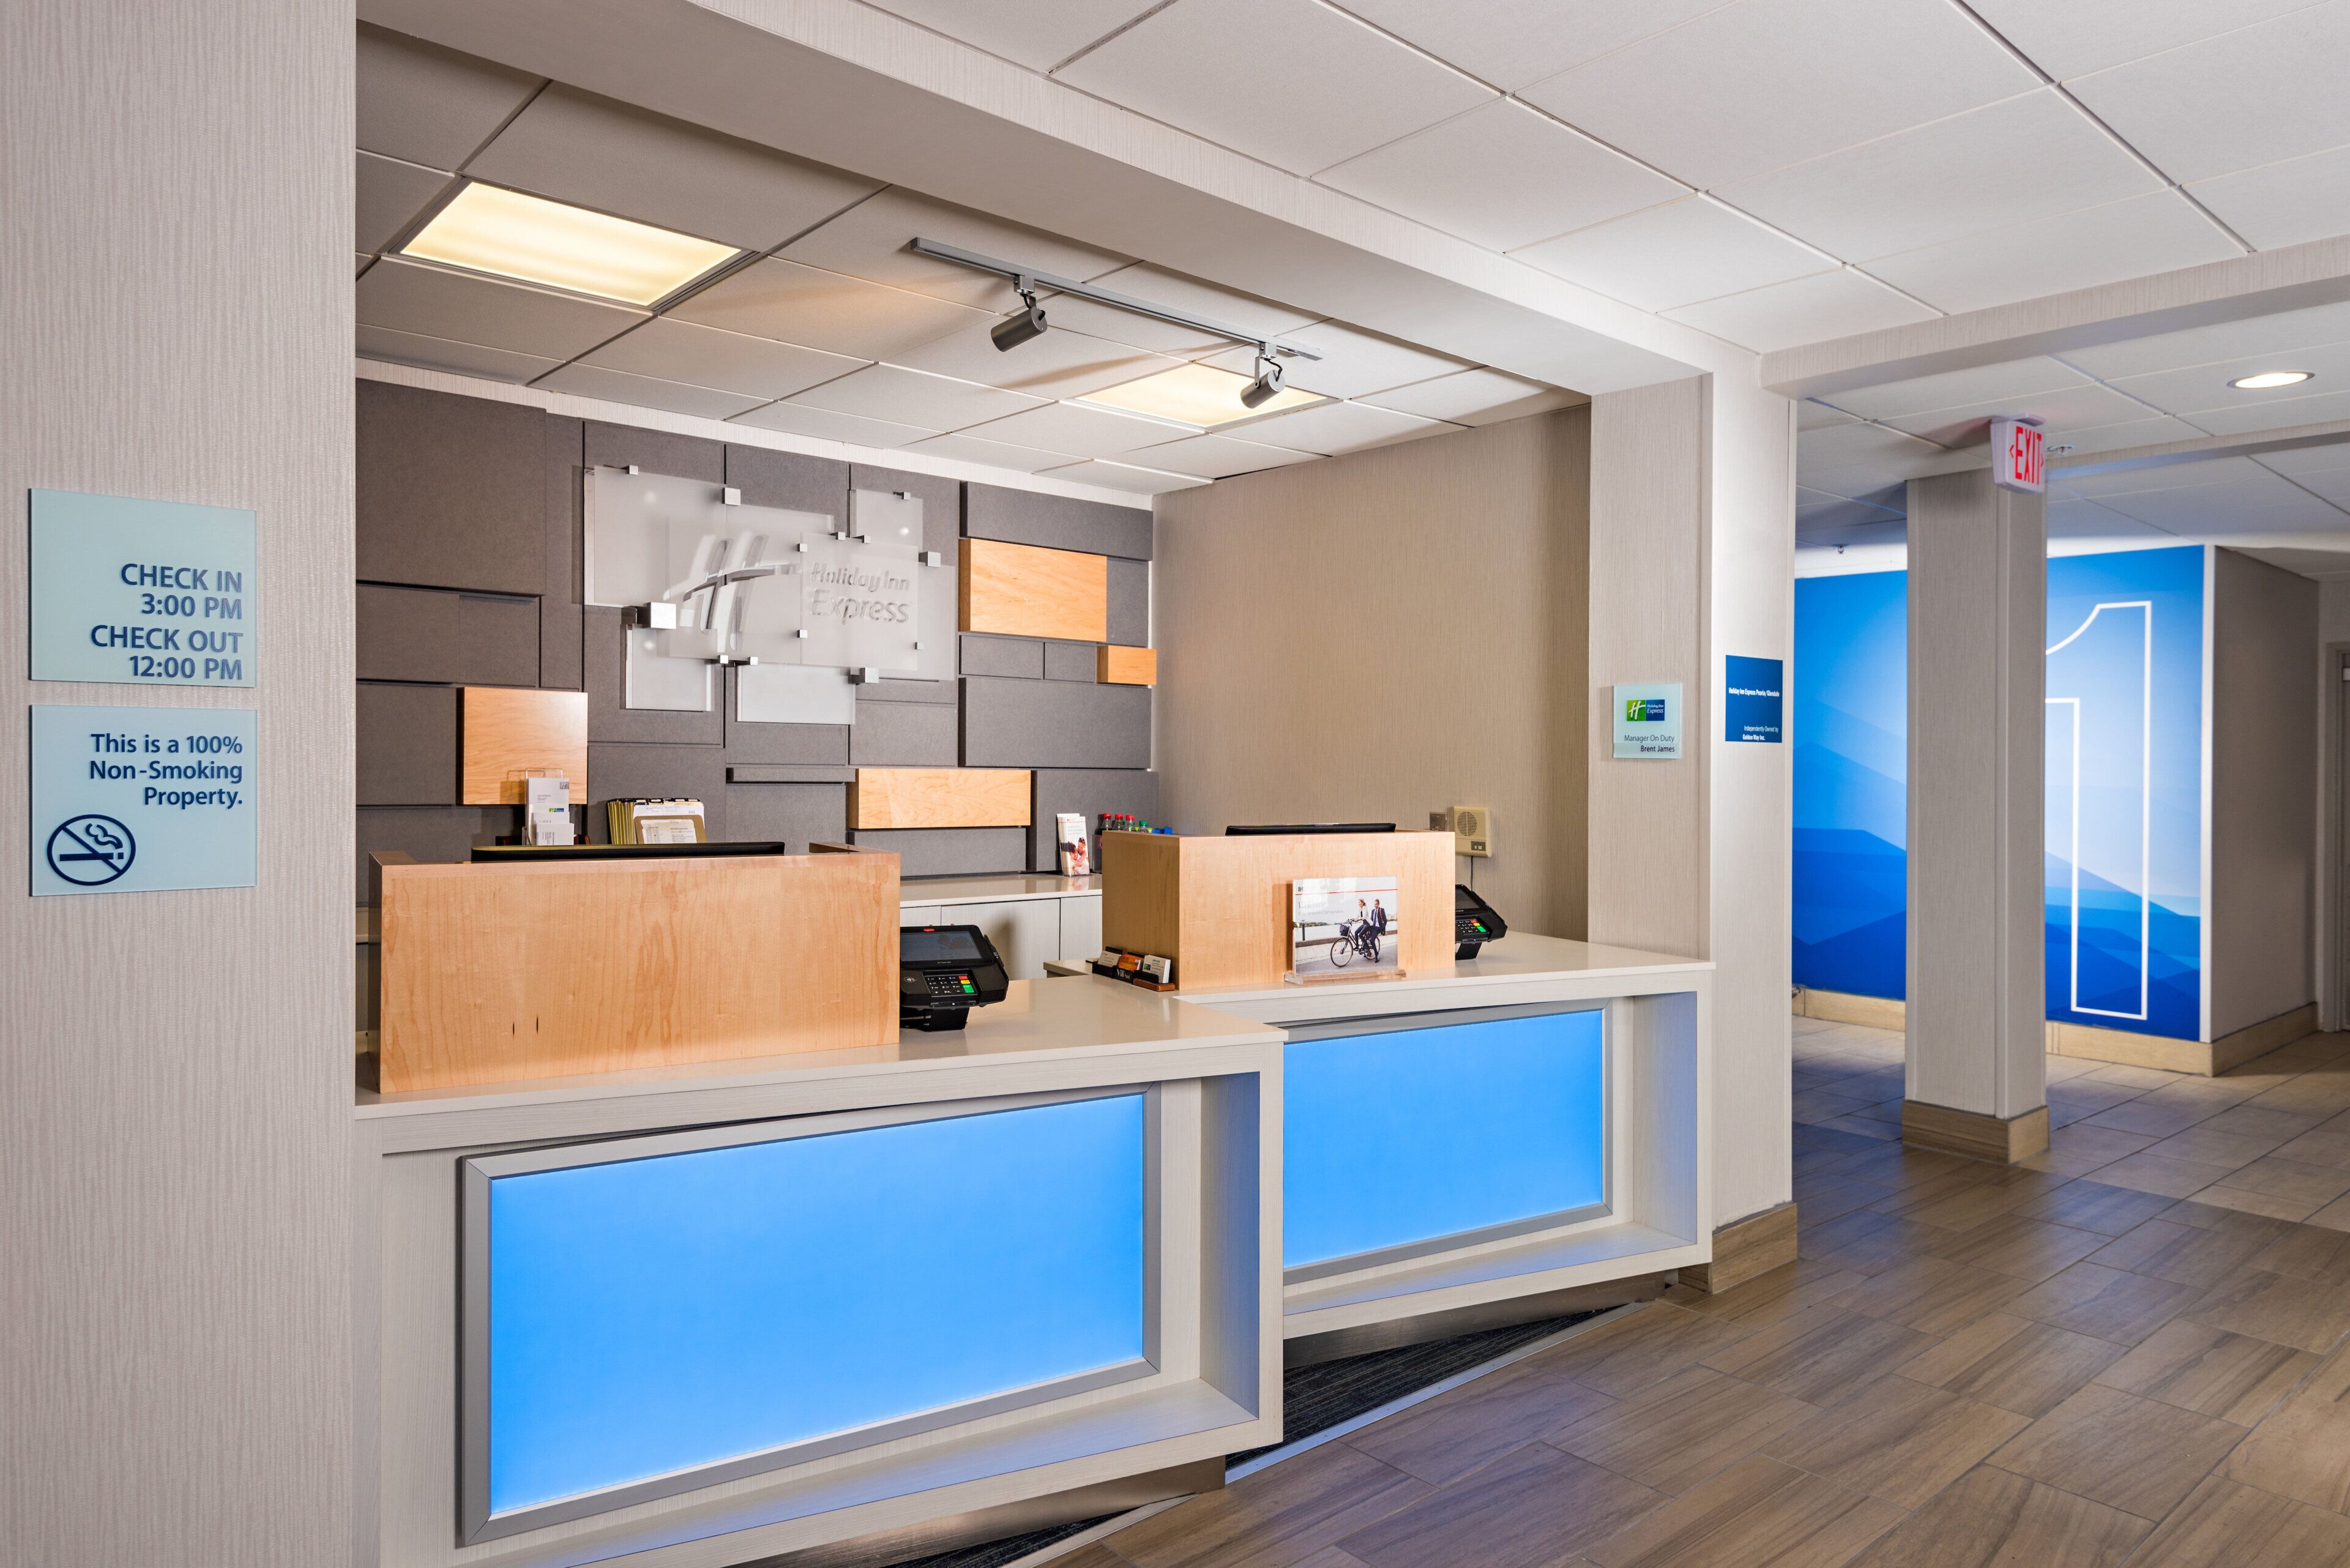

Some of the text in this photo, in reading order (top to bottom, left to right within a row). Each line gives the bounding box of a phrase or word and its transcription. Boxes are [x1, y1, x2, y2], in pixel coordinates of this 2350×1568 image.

[2015, 426, 2042, 485] EXIT
[121, 564, 242, 592] CHECK IN
[811, 562, 911, 592] Holiday Inn
[141, 593, 242, 619] 3:00 PM
[811, 589, 910, 625] Express
[91, 625, 244, 653] CHECK OUT
[130, 655, 242, 680] 12:00 PM
[91, 733, 243, 754] This is a 100%
[91, 761, 242, 784] Non-Smoking
[145, 787, 242, 809] Property.
